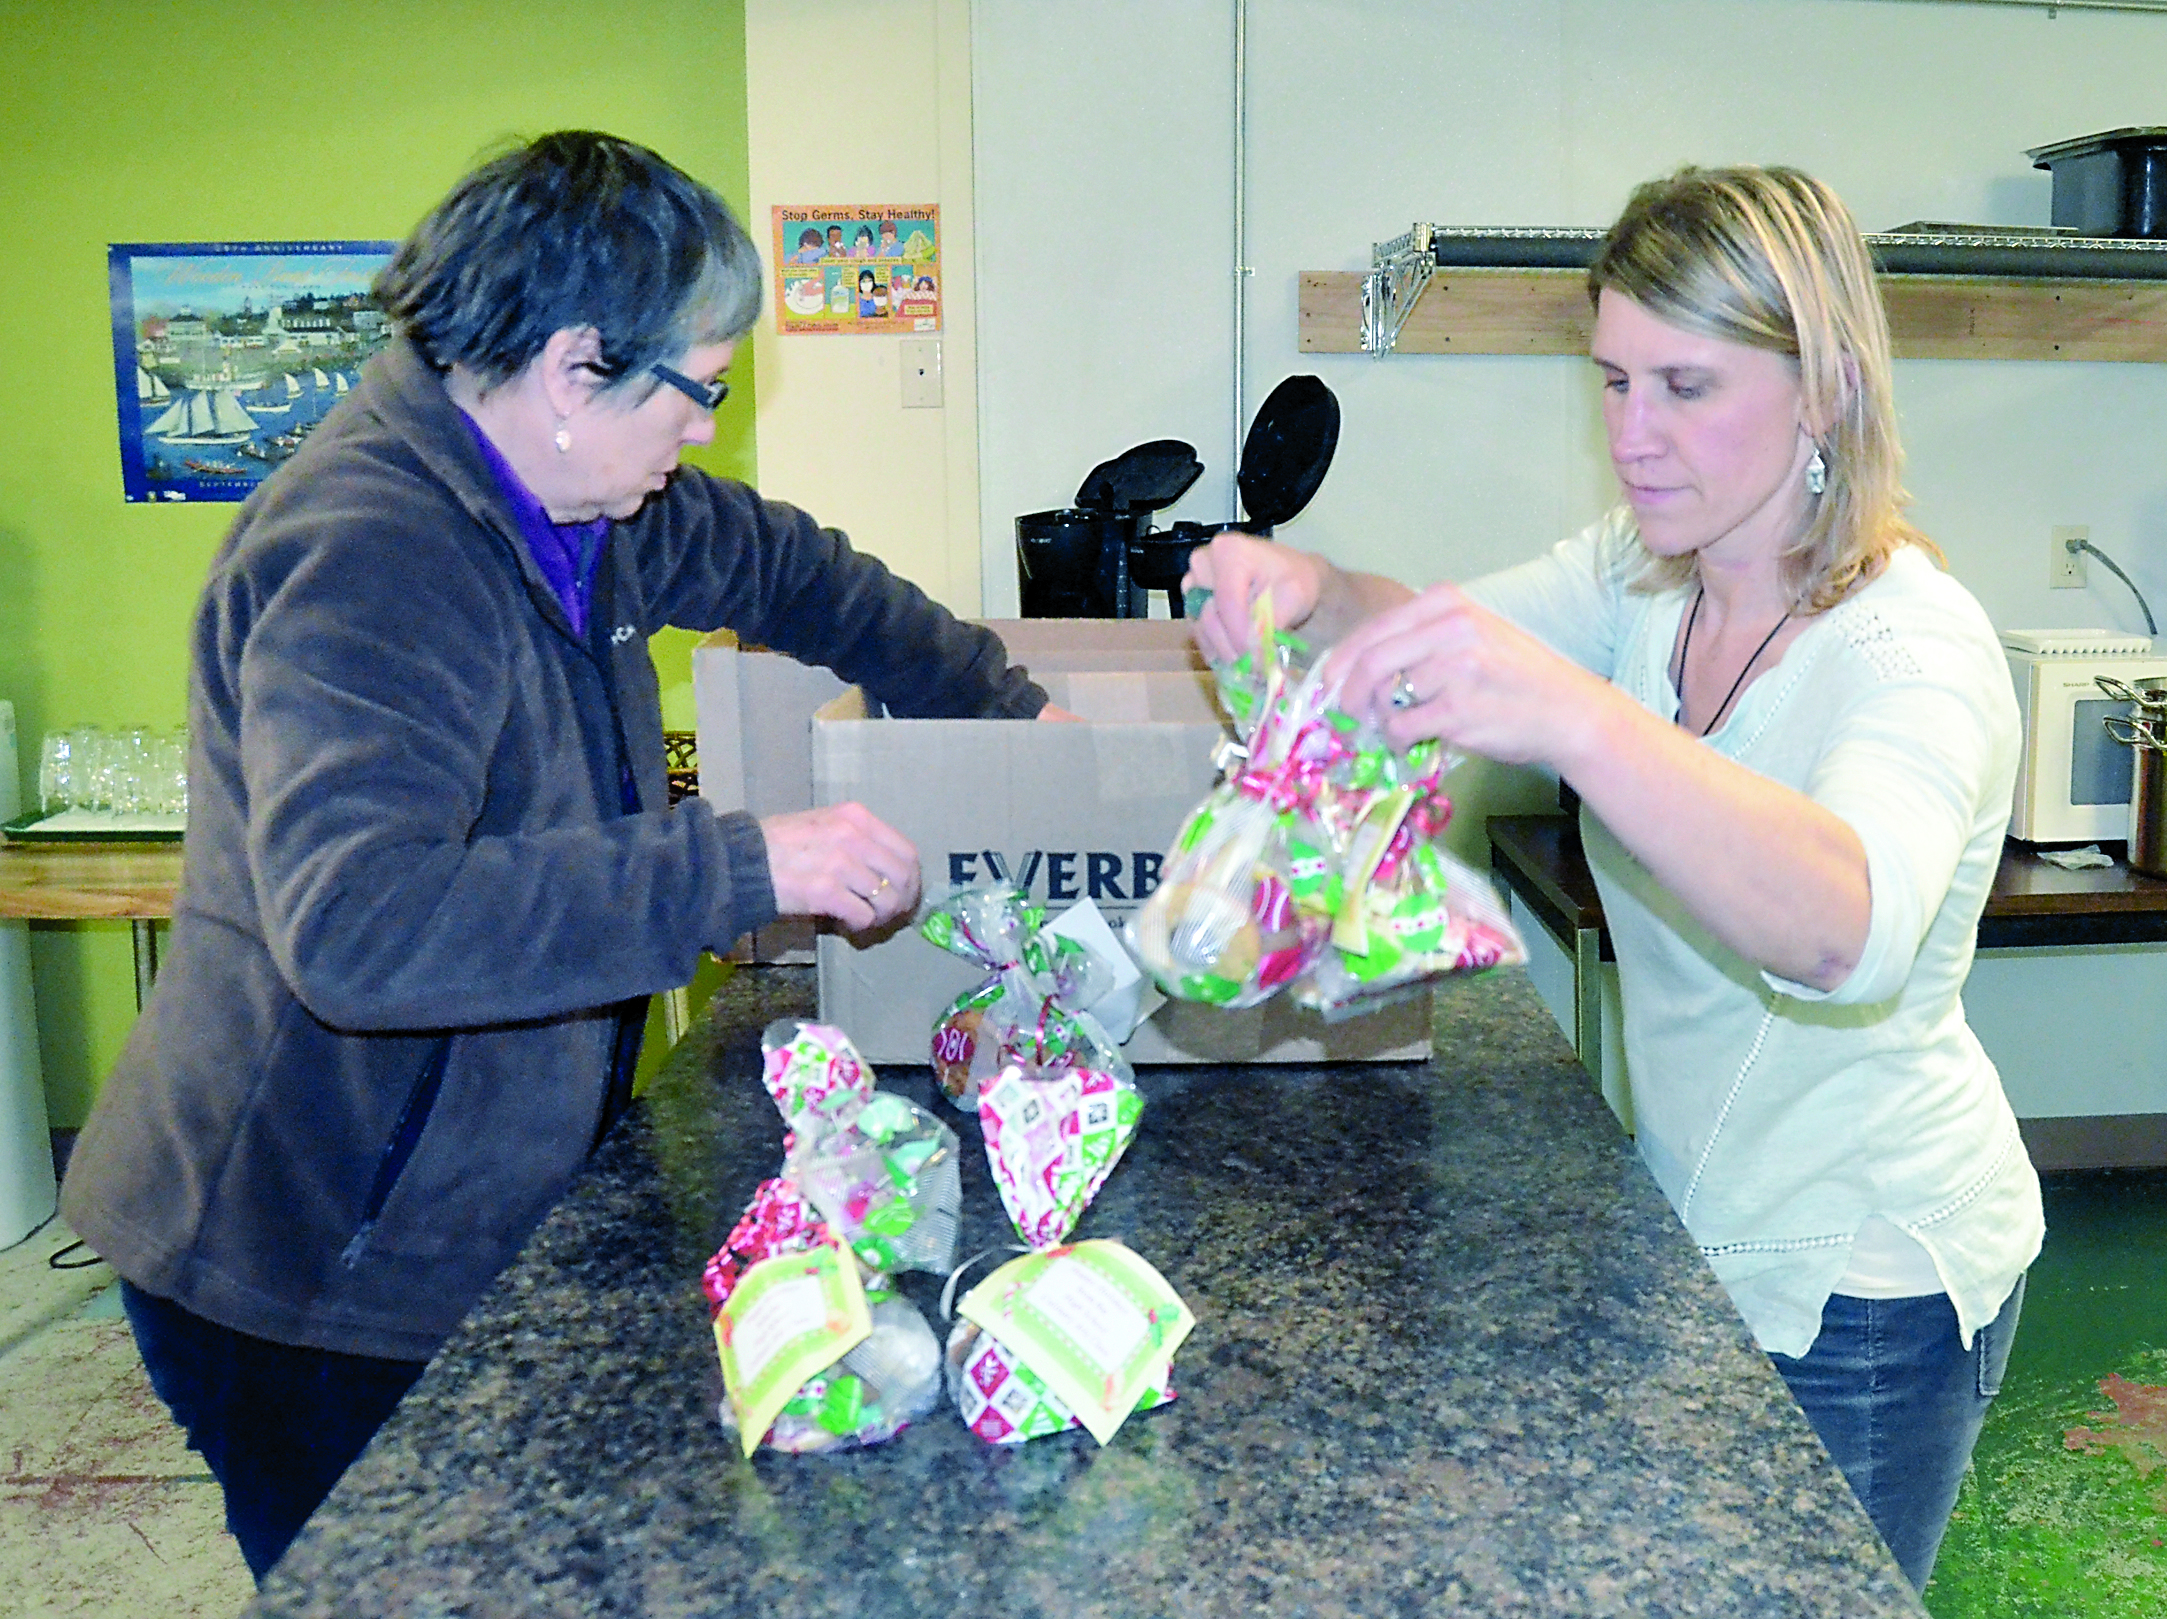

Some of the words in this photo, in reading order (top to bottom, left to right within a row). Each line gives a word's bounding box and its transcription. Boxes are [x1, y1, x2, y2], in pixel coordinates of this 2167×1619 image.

[782, 209, 808, 222] Stop
[812, 209, 854, 221] Germs,
[858, 209, 884, 221] Stay
[888, 209, 935, 221] Healthy!
[254, 244, 343, 252] ANNIVERSARY
